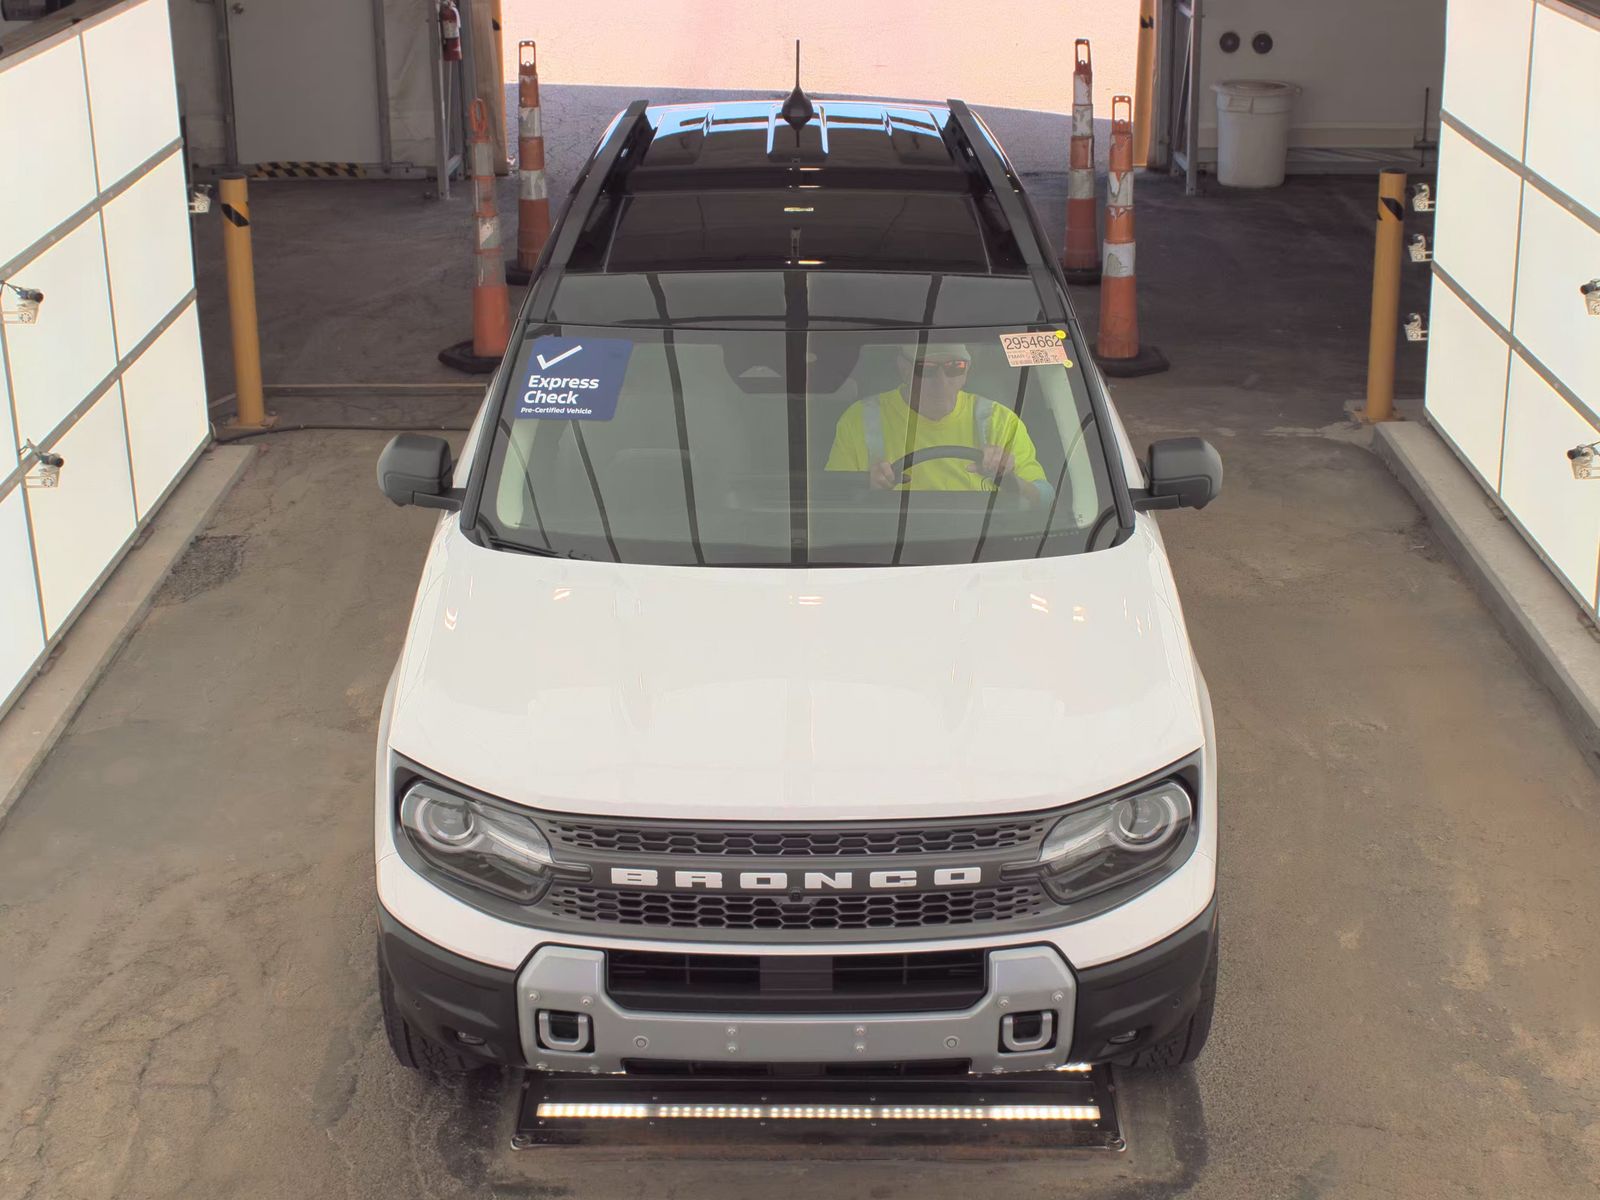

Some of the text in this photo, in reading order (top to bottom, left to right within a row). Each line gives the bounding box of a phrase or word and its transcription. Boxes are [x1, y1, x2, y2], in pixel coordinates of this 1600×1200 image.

[1004, 334, 1063, 350] 2954662
[528, 375, 600, 390] Express
[524, 390, 579, 405] Check
[520, 406, 592, 415] Pre-Certified Vehicle
[611, 867, 981, 889] BRONCO
